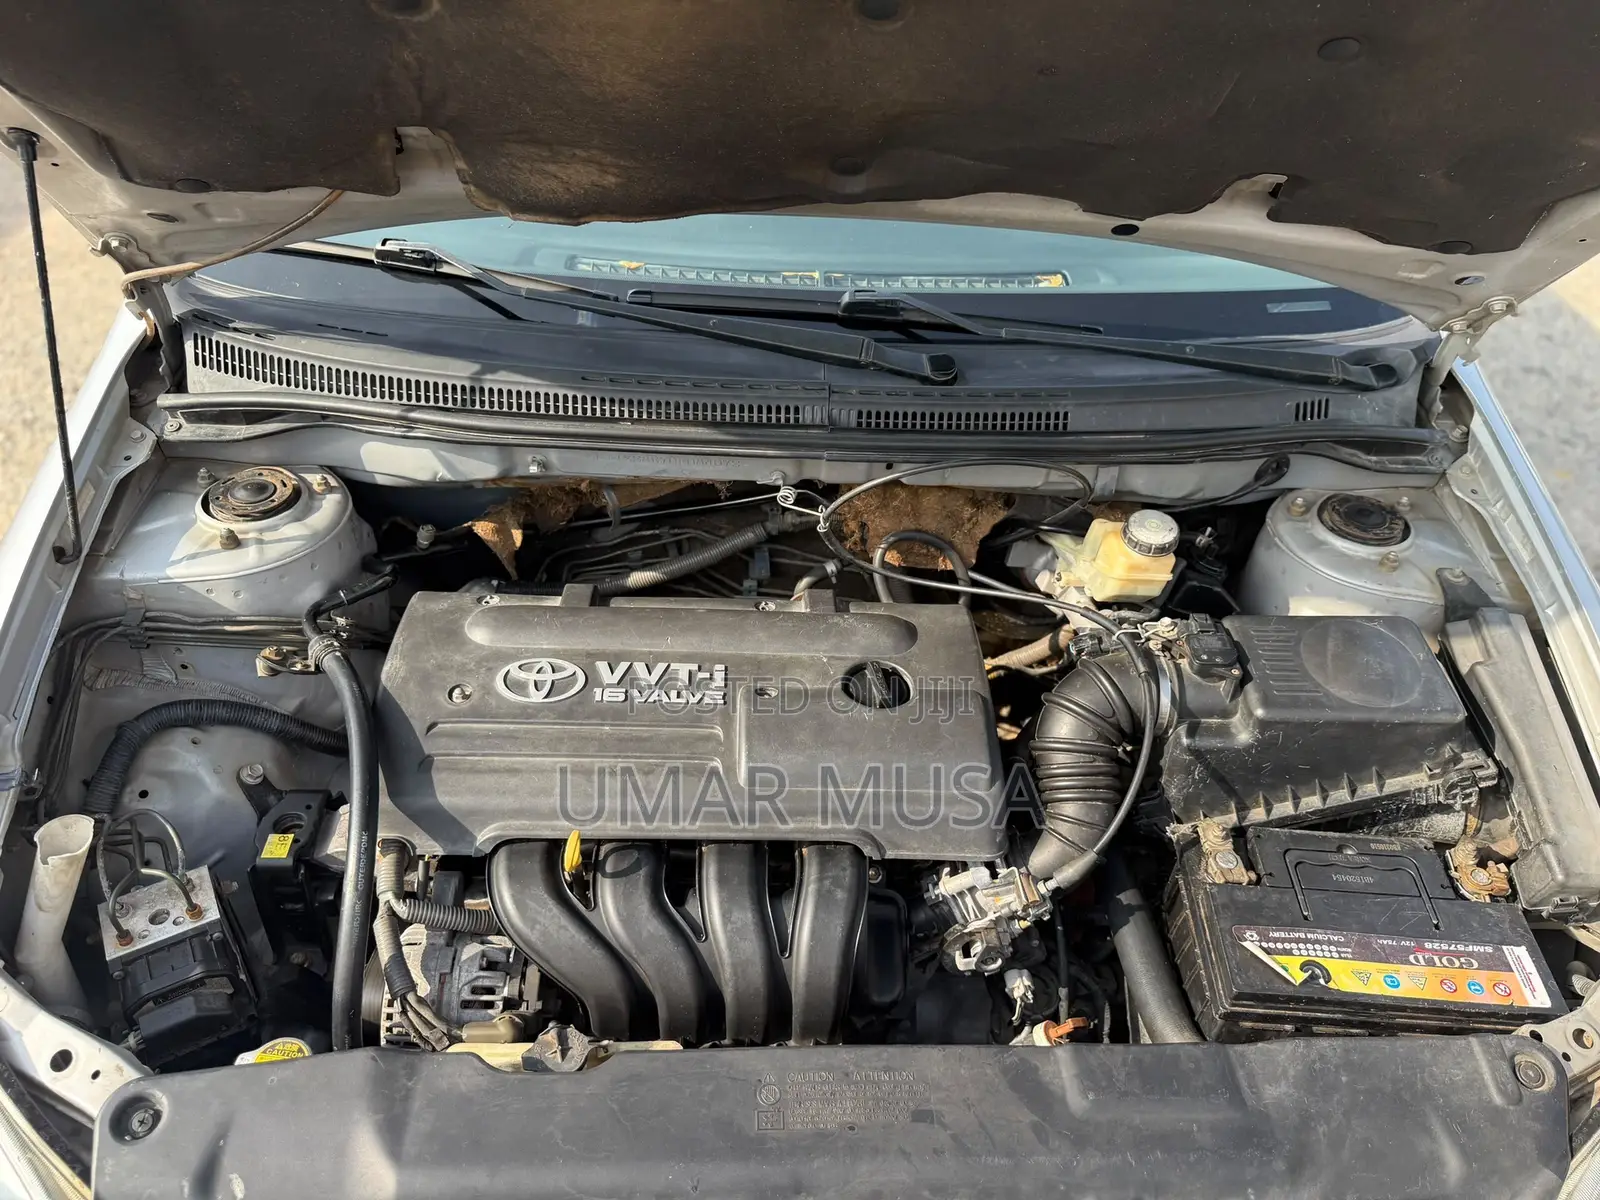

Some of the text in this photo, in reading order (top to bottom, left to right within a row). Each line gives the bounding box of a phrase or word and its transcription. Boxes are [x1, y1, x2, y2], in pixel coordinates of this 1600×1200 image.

[595, 661, 728, 687] VVT-i
[593, 688, 727, 705] 16 VALVE
[1268, 930, 1345, 942] CALCIUM BATTERY
[1409, 953, 1479, 970] GOLD
[266, 1049, 304, 1058] CAUTION
[787, 1070, 916, 1082] CAUTION ATTENTION
